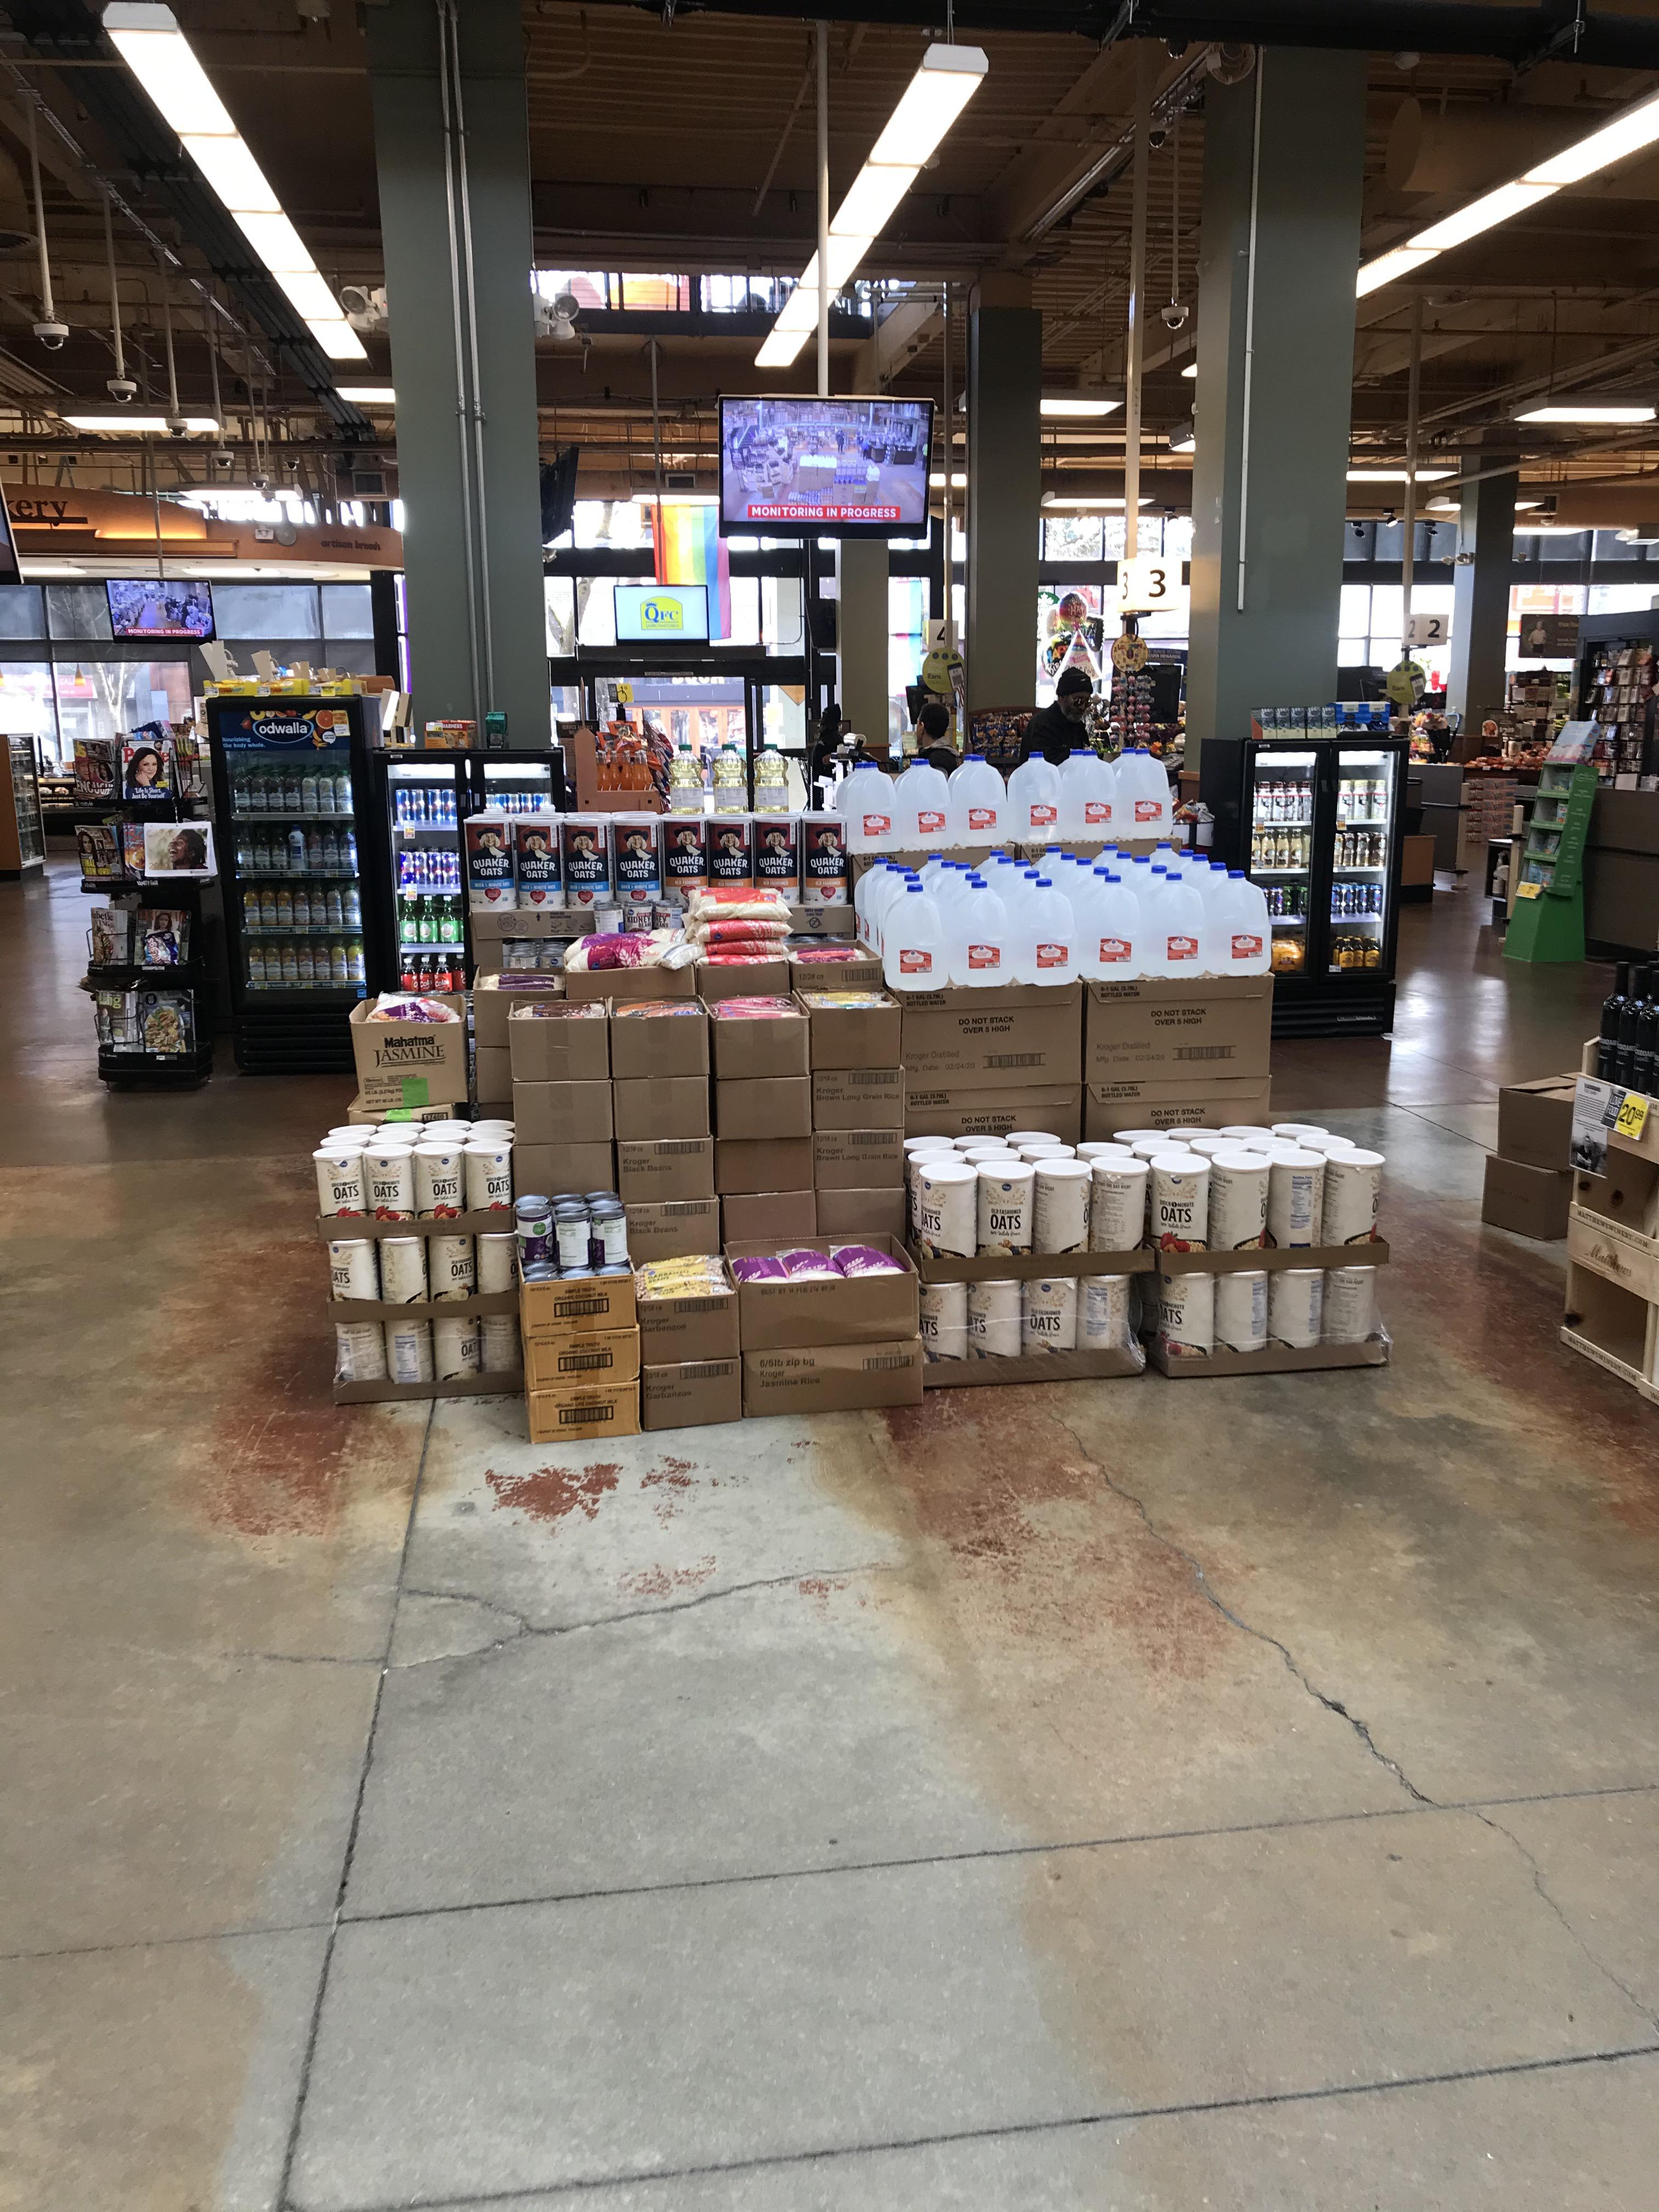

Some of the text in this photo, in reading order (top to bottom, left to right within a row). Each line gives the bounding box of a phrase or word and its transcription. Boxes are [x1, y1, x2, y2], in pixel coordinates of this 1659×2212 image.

[752, 506, 896, 518] MONITORING IN PROGRESS
[1122, 572, 1128, 600] 3
[1148, 569, 1166, 597] 3
[645, 606, 679, 623] QFC
[1408, 619, 1415, 638] 2
[1427, 619, 1441, 638] 2
[259, 722, 308, 734] odwalla
[473, 857, 509, 868] QUAKER
[520, 861, 555, 871] QUAKER
[568, 861, 603, 872] QUAKER
[620, 860, 655, 871] QUAKER
[669, 856, 704, 867] QUAKER
[714, 858, 748, 868] QUAKER
[759, 857, 793, 867] QUAKER
[810, 857, 844, 867] QUAKER
[481, 867, 503, 876] OATS
[526, 870, 548, 878] OATS
[574, 870, 596, 878] OATS
[720, 867, 741, 876] OATS
[765, 866, 786, 874] OATS
[817, 866, 838, 874] OATS
[384, 1035, 435, 1048] Mahatma
[1097, 1043, 1121, 1052] Kroger
[373, 1044, 445, 1068] JASMINE
[906, 1051, 960, 1061] Kroger Distilled
[1607, 1105, 1619, 1117] FOOD
[1618, 1103, 1636, 1125] 20
[334, 1184, 359, 1200] OATS
[374, 1185, 399, 1198] OATS
[433, 1182, 457, 1196] OATS
[488, 1179, 510, 1194] OATS
[1160, 1206, 1192, 1223] OATS
[990, 1214, 1022, 1230] OATS
[1577, 1209, 1648, 1248] MATTHEWSWINERY.COM
[1584, 1243, 1633, 1277] Matthews
[451, 1261, 473, 1277] OATS
[648, 1270, 689, 1280] GARBANZO
[641, 1324, 686, 1333] Garbanzos
[1030, 1316, 1060, 1331] OATS
[759, 1357, 815, 1368] 6/5lb zip bg
[759, 1379, 798, 1388] Jasmine
[646, 1391, 692, 1400] Garbanzos
